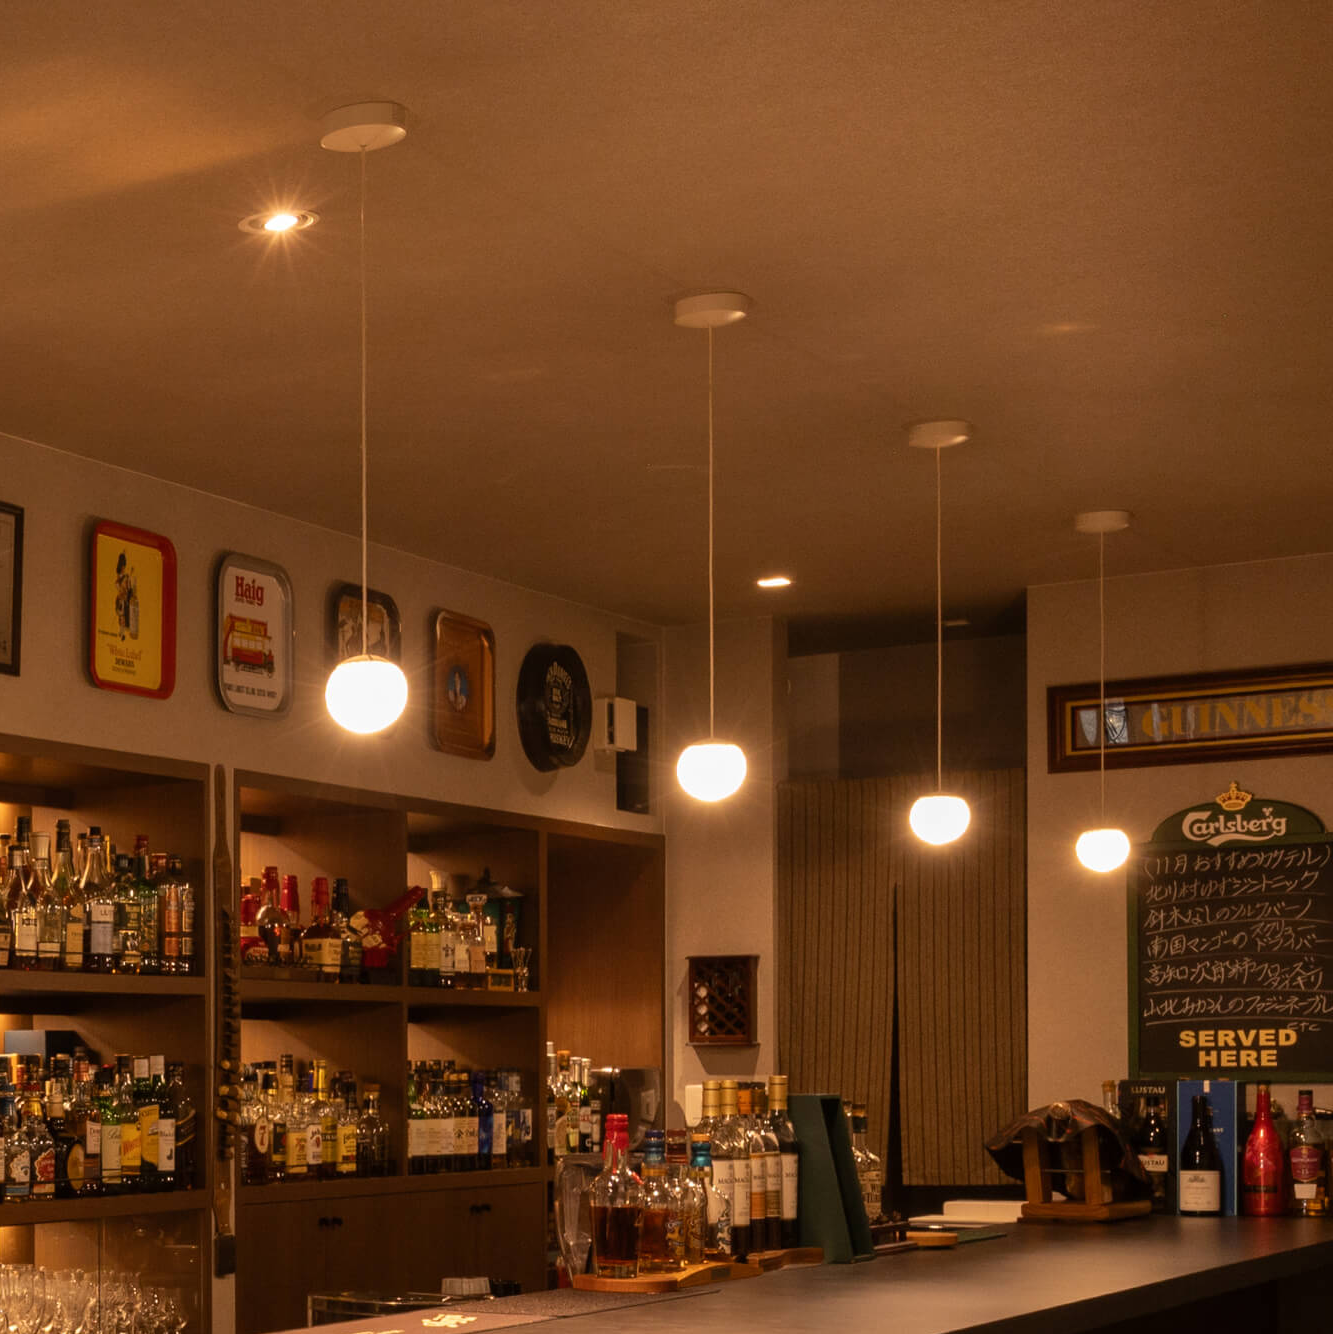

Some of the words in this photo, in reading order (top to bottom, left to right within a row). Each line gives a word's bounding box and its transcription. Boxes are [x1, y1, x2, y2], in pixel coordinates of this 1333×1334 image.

[235, 575, 265, 606] Haig
[1182, 807, 1287, 846] Carlsberg
[1179, 1028, 1298, 1047] SERVED
[1198, 1049, 1278, 1067] HERE
[1140, 1158, 1165, 1167] USTAU
